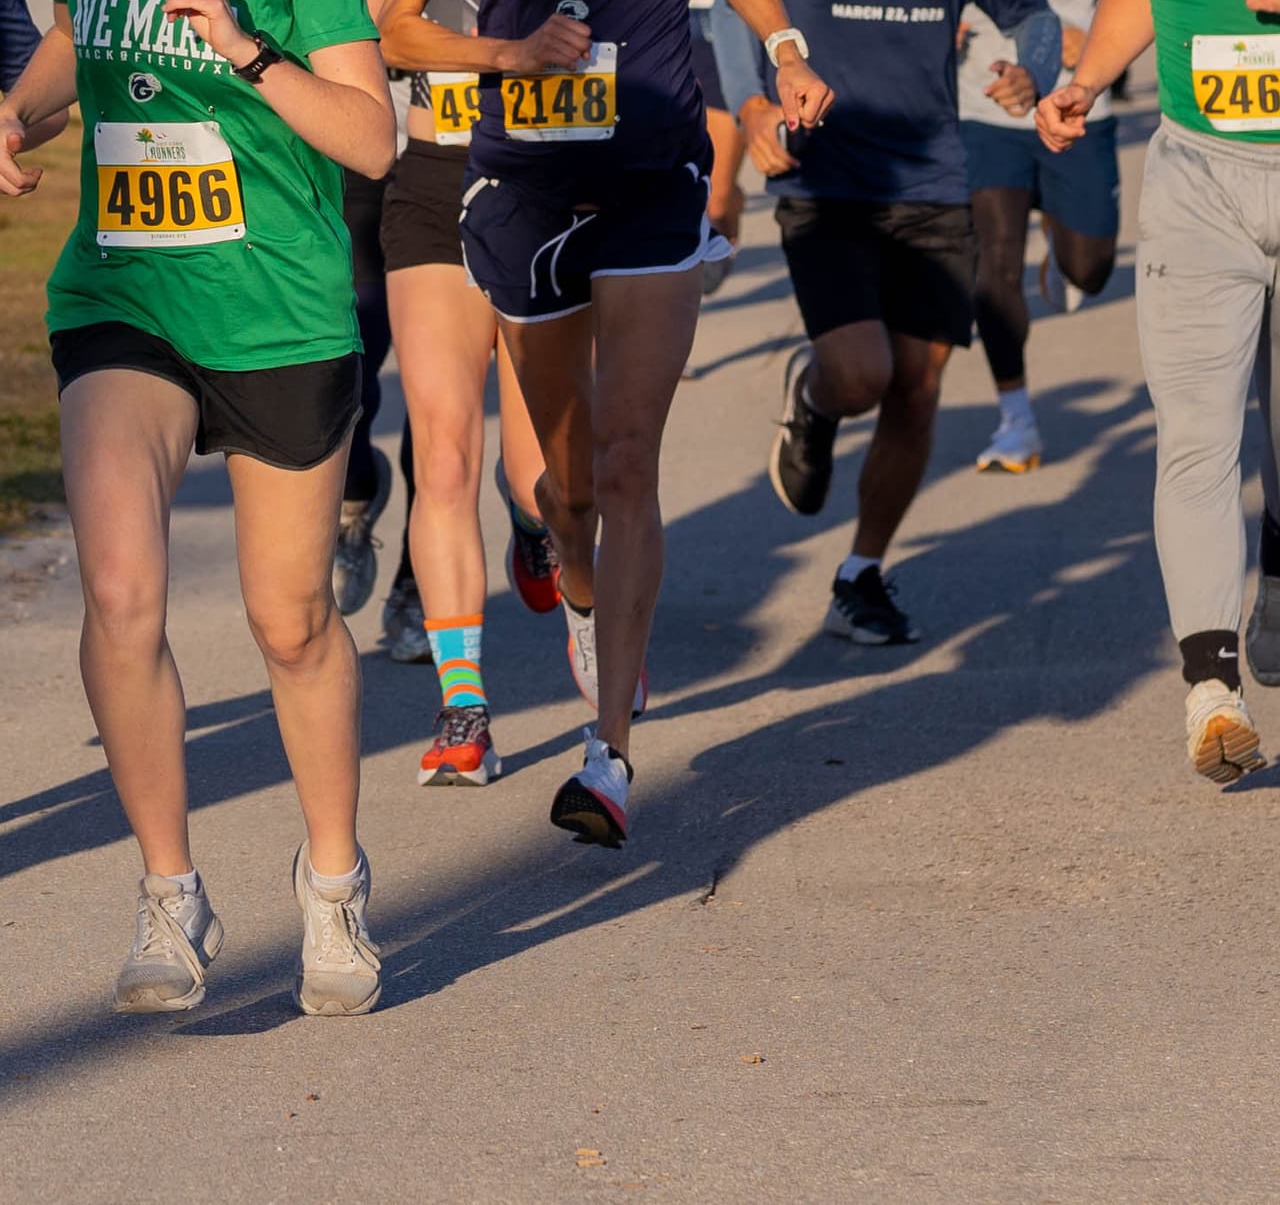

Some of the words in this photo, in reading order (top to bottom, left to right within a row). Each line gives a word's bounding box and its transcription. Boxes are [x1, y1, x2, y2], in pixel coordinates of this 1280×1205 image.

[831, 3, 884, 21] MARCH
[884, 6, 909, 24] 22,
[440, 84, 482, 128] 49
[507, 77, 608, 126] 2148
[150, 145, 187, 161] RUNNERS
[106, 168, 233, 227] 4966
